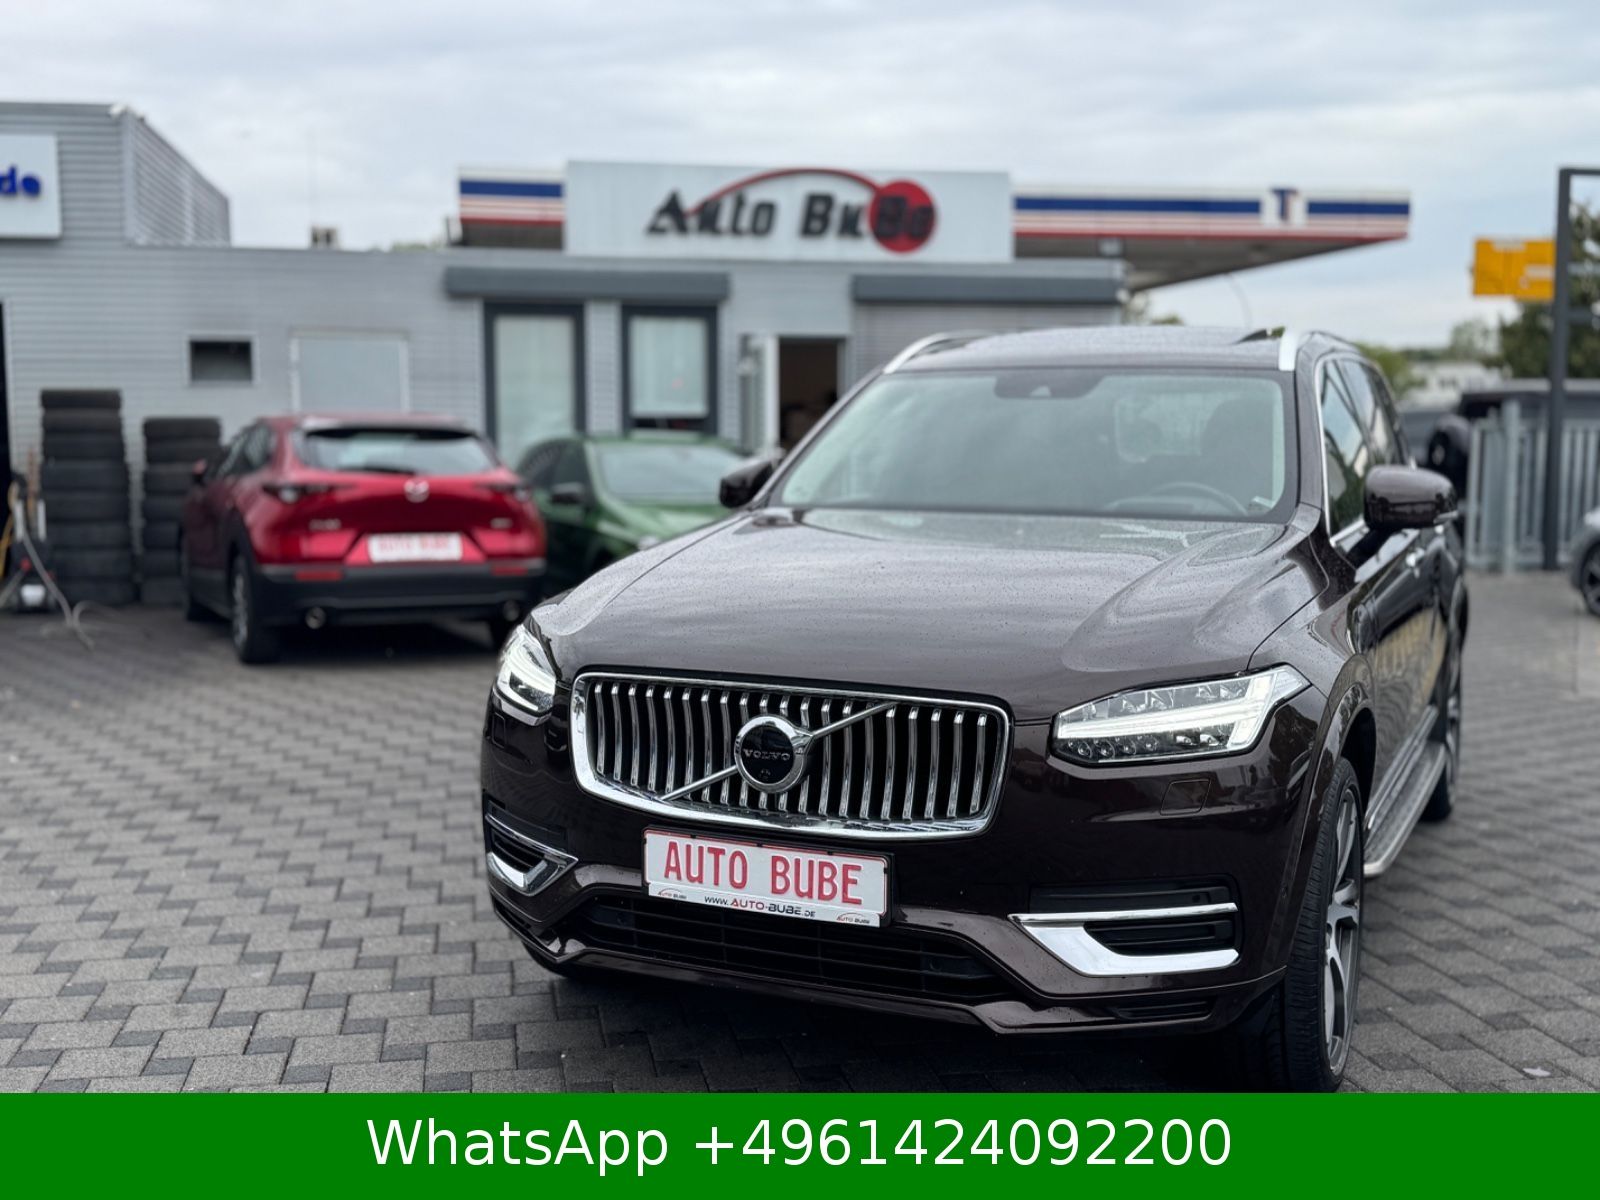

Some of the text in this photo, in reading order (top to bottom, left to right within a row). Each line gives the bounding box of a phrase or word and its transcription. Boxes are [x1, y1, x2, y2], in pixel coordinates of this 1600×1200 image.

[743, 748, 790, 761] VOLVO
[664, 841, 862, 905] AUTO BUBE
